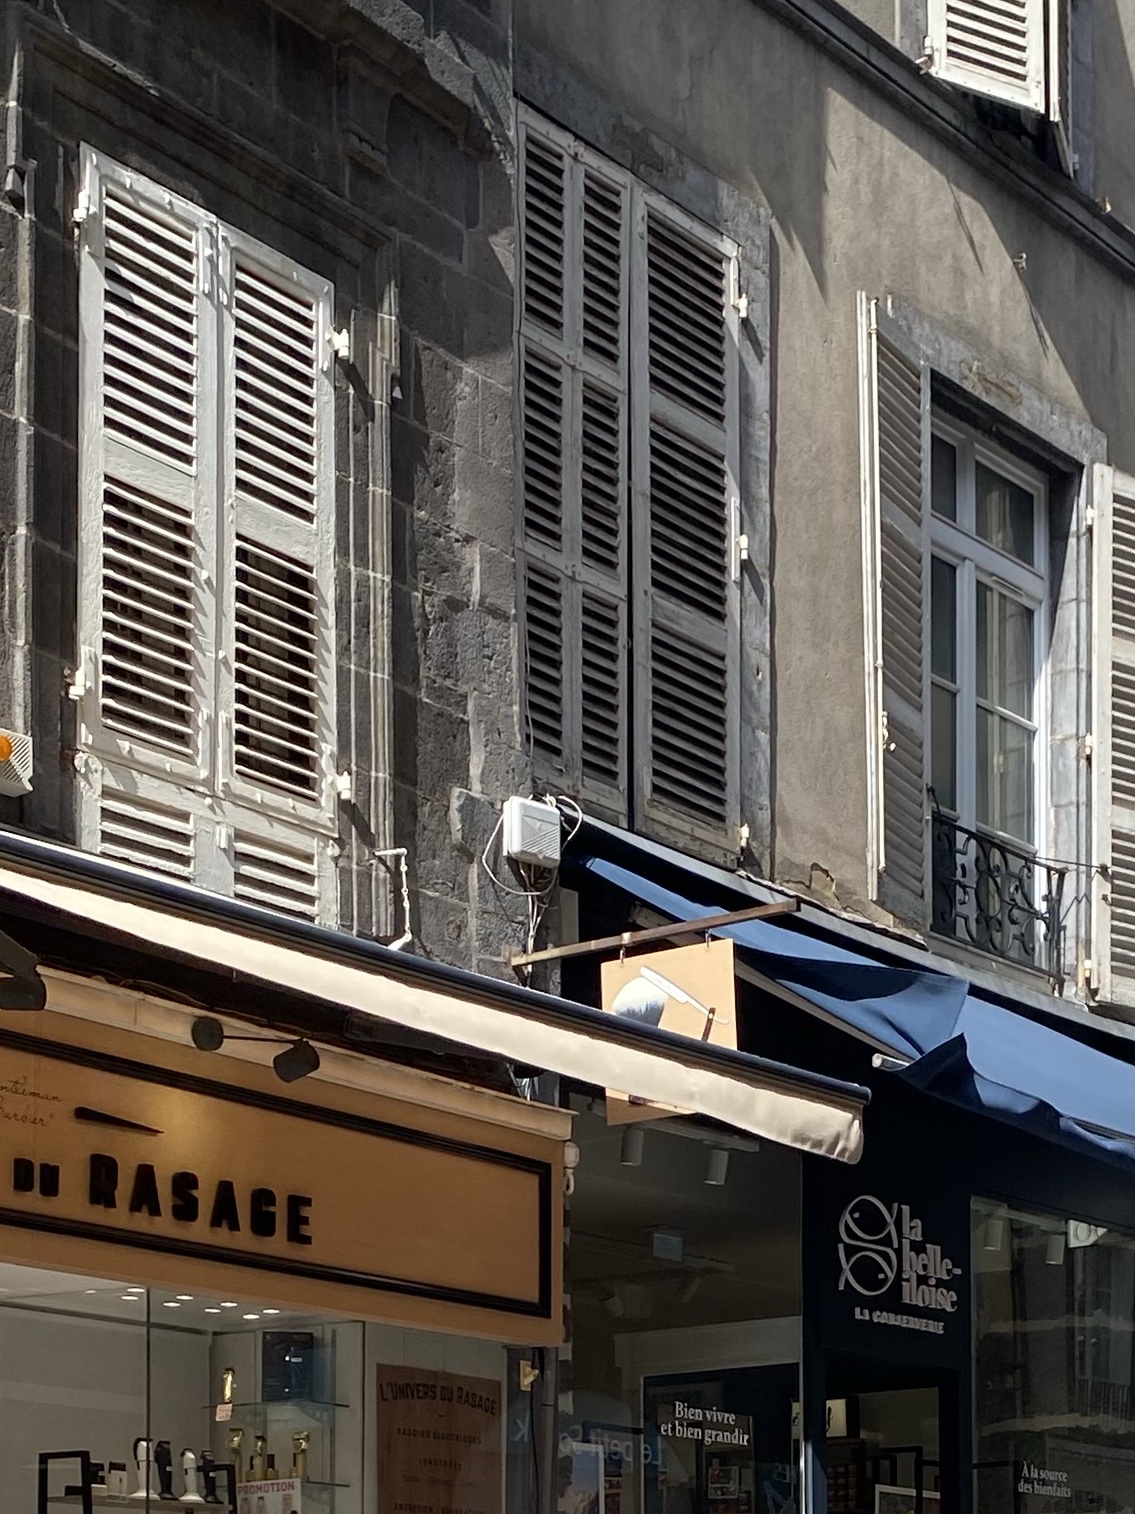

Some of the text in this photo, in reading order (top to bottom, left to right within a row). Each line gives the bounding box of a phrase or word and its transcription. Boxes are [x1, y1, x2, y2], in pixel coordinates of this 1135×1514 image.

[0, 1074, 62, 1102] ntleman
[13, 1153, 313, 1245] DU RASAGE
[900, 1204, 923, 1241] la
[901, 1238, 962, 1280] belle-
[854, 1307, 945, 1334] LA CONSERVERIE
[379, 1381, 497, 1416] L'UNIVERS DU RASAGE
[674, 1401, 736, 1425] Bien vivre
[660, 1420, 749, 1446] et bien grandir
[1030, 1464, 1038, 1478] la
[1040, 1469, 1068, 1482] source
[238, 1481, 294, 1494] PROMOTION
[1018, 1478, 1071, 1498] des bienfaits
